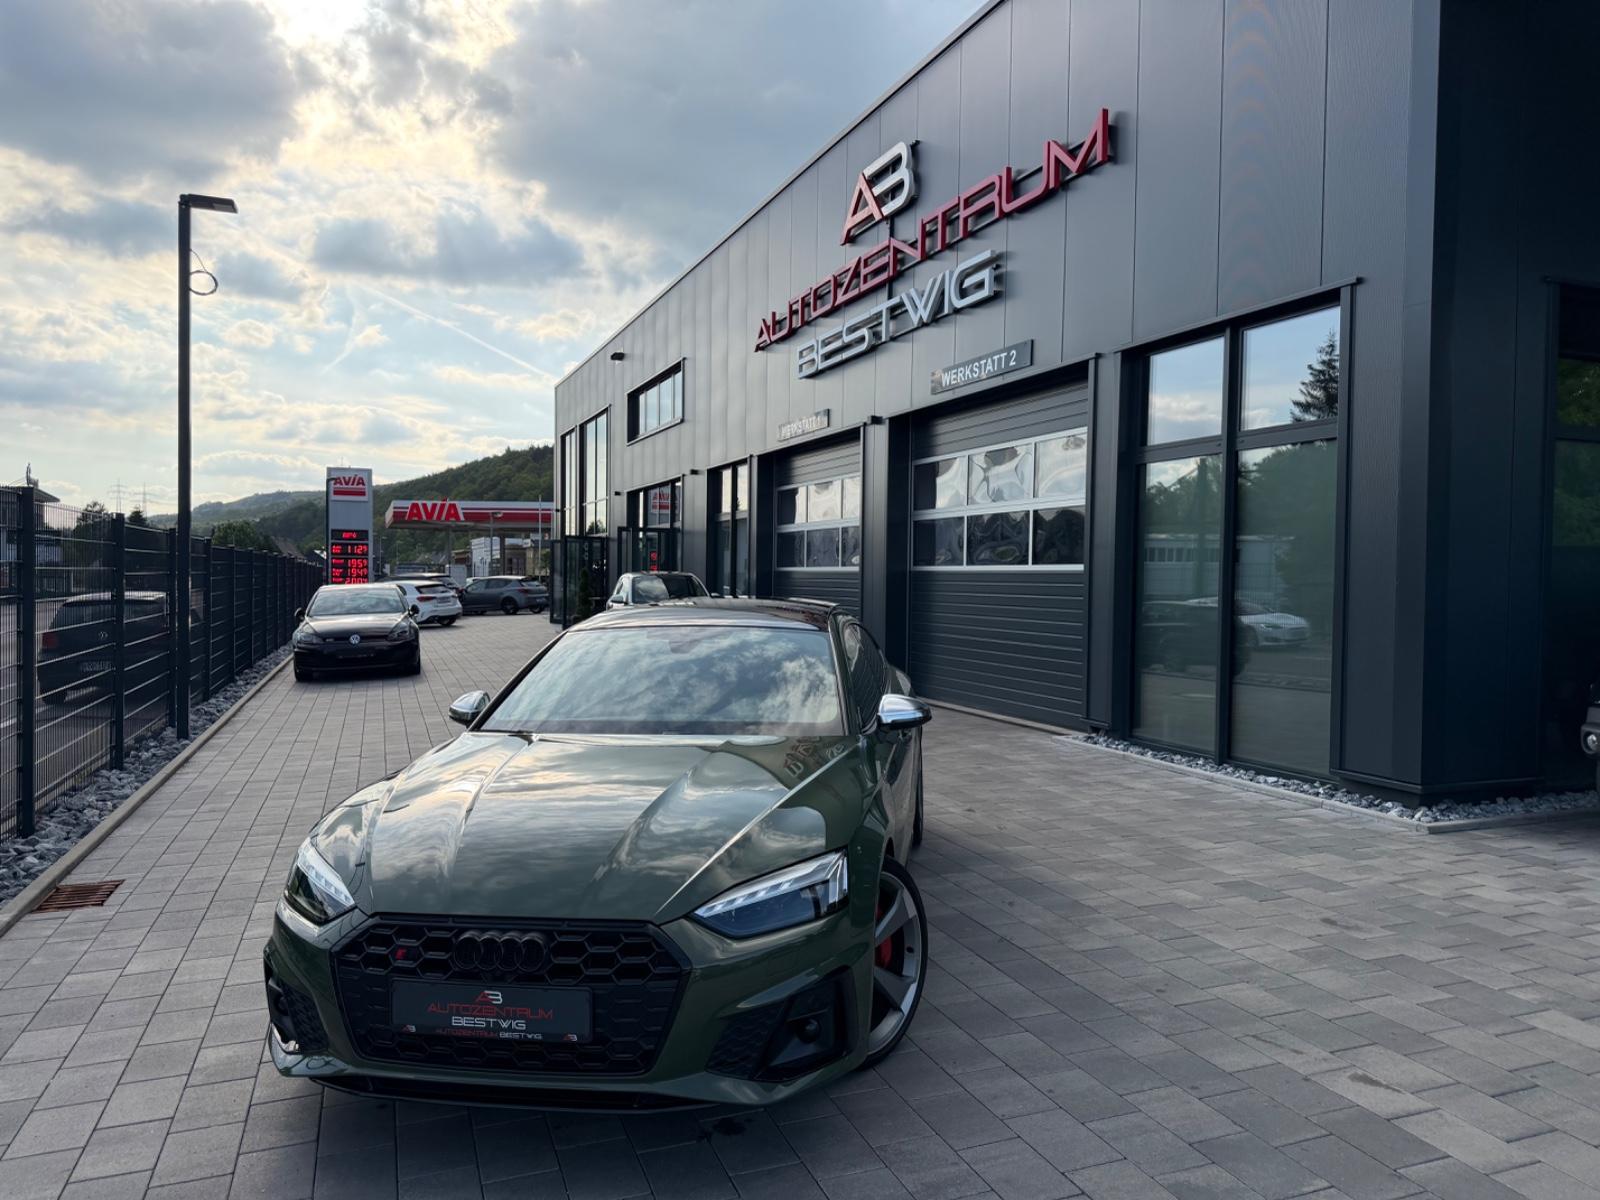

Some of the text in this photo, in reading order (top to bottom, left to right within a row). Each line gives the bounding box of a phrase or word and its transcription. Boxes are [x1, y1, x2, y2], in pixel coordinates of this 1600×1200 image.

[754, 107, 1110, 352] AUTOZENTRUM
[797, 249, 1002, 379] BESTWIG
[940, 349, 1017, 388] WERKSTATT 2
[333, 474, 366, 486] AVIA
[407, 497, 462, 521] AVIA
[427, 1002, 553, 1020] AUTOZENTRUM
[452, 1016, 526, 1030] BESTWIG
[436, 1028, 543, 1040] AUTOZENTRUM BESTWIG
